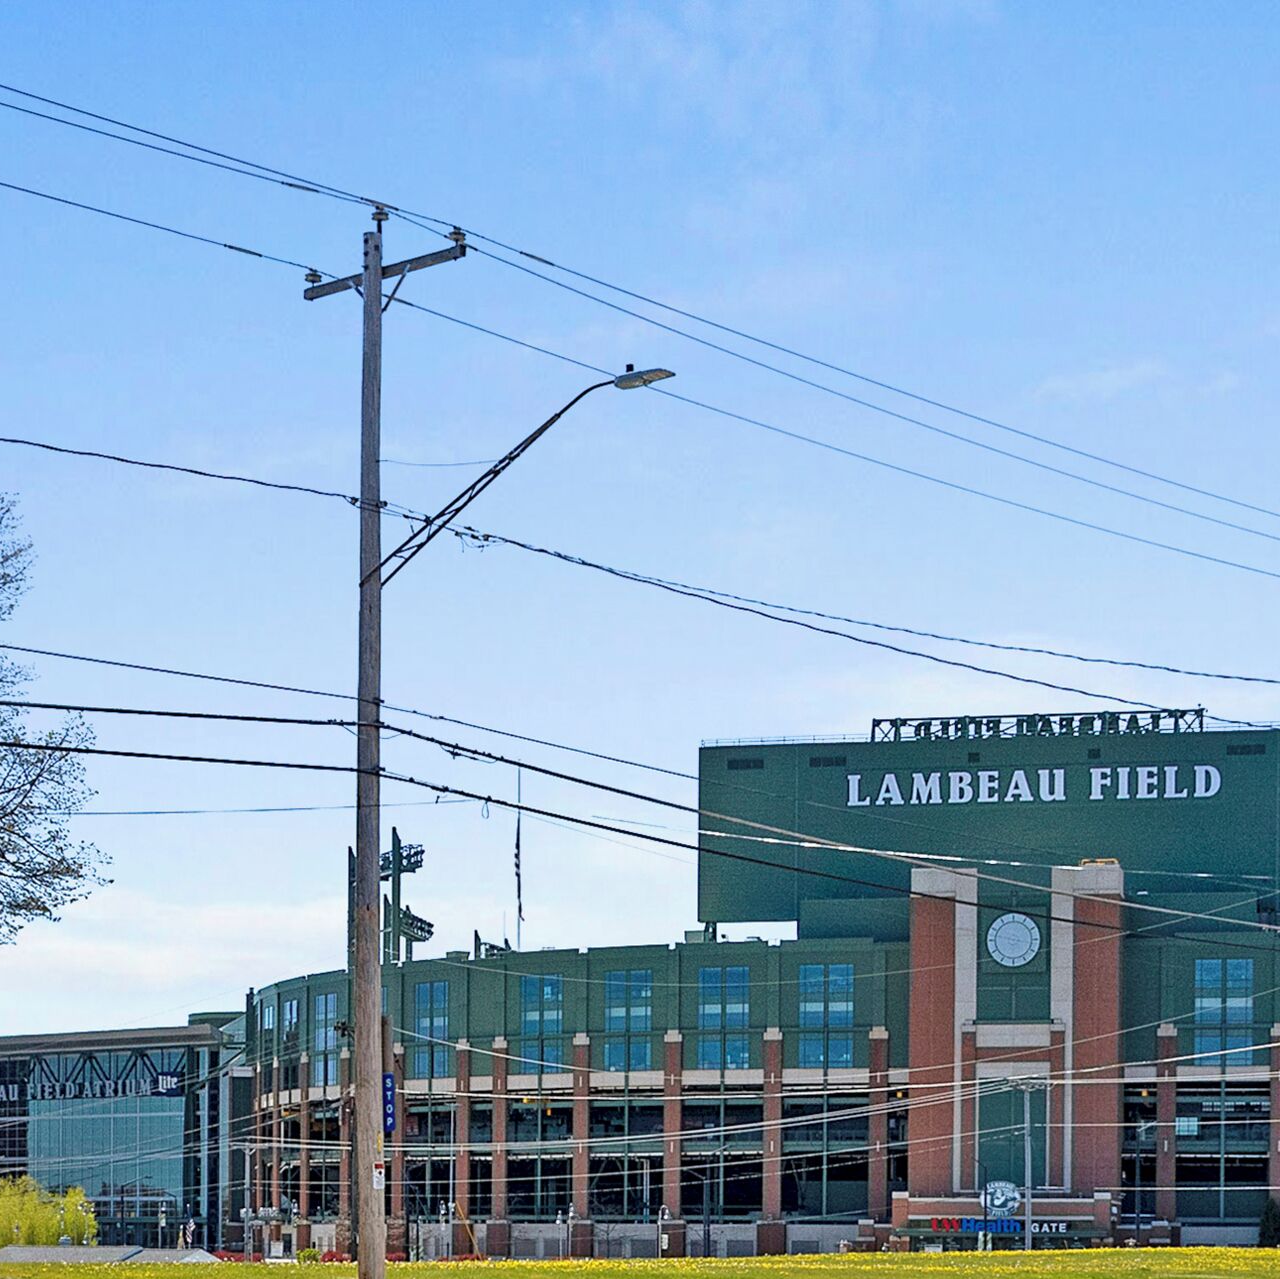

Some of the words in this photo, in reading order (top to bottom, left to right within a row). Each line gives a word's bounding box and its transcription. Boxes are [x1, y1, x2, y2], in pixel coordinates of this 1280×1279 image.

[846, 768, 1066, 807] LAMBEAU
[1089, 765, 1221, 800] FIELD
[26, 1082, 76, 1100] FIELD
[82, 1079, 153, 1099] ATRIUM
[157, 1074, 178, 1093] Lite
[1031, 1222, 1067, 1233] GATE
